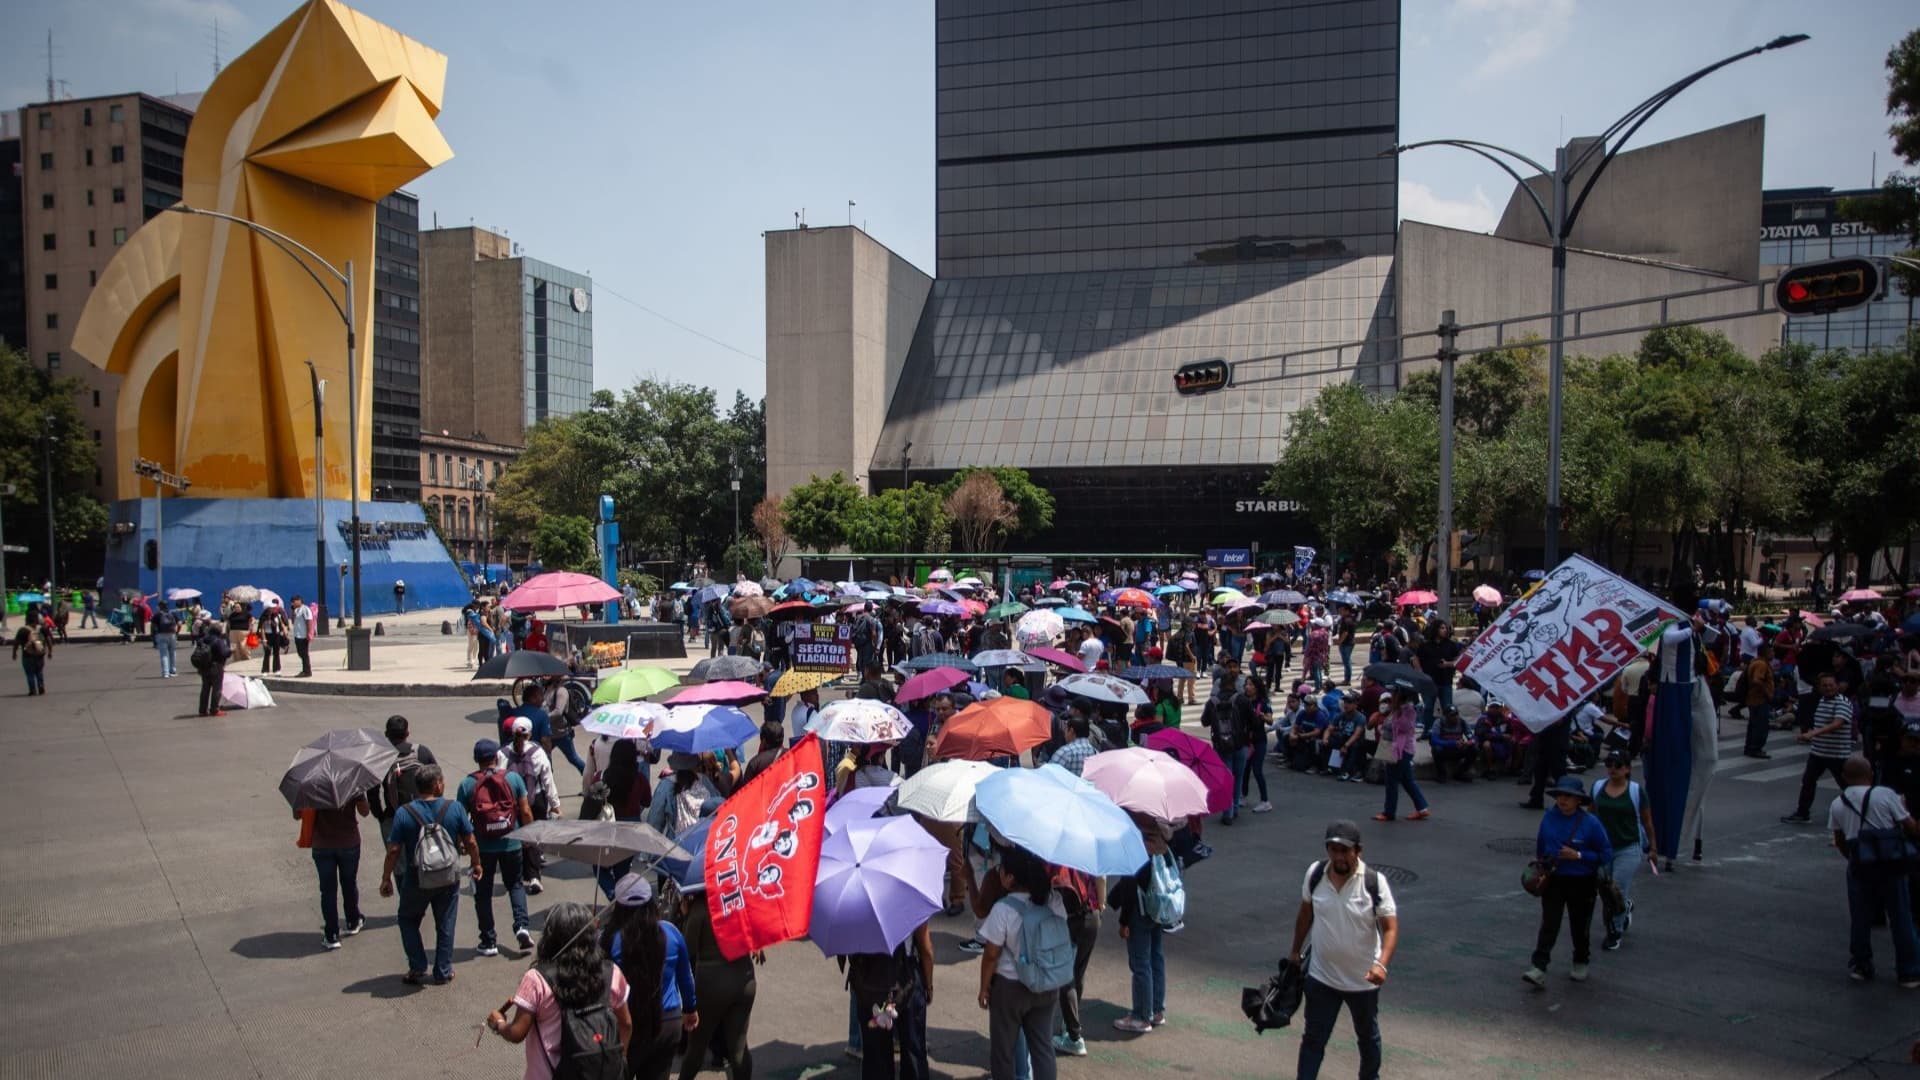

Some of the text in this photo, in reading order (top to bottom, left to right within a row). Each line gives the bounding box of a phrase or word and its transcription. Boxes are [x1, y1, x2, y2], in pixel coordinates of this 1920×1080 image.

[1235, 500, 1310, 512] STARBU
[1223, 553, 1244, 562] telcel
[799, 644, 845, 654] SECTOR
[797, 654, 846, 664] TLACOLULA
[714, 814, 744, 916] CNTE
